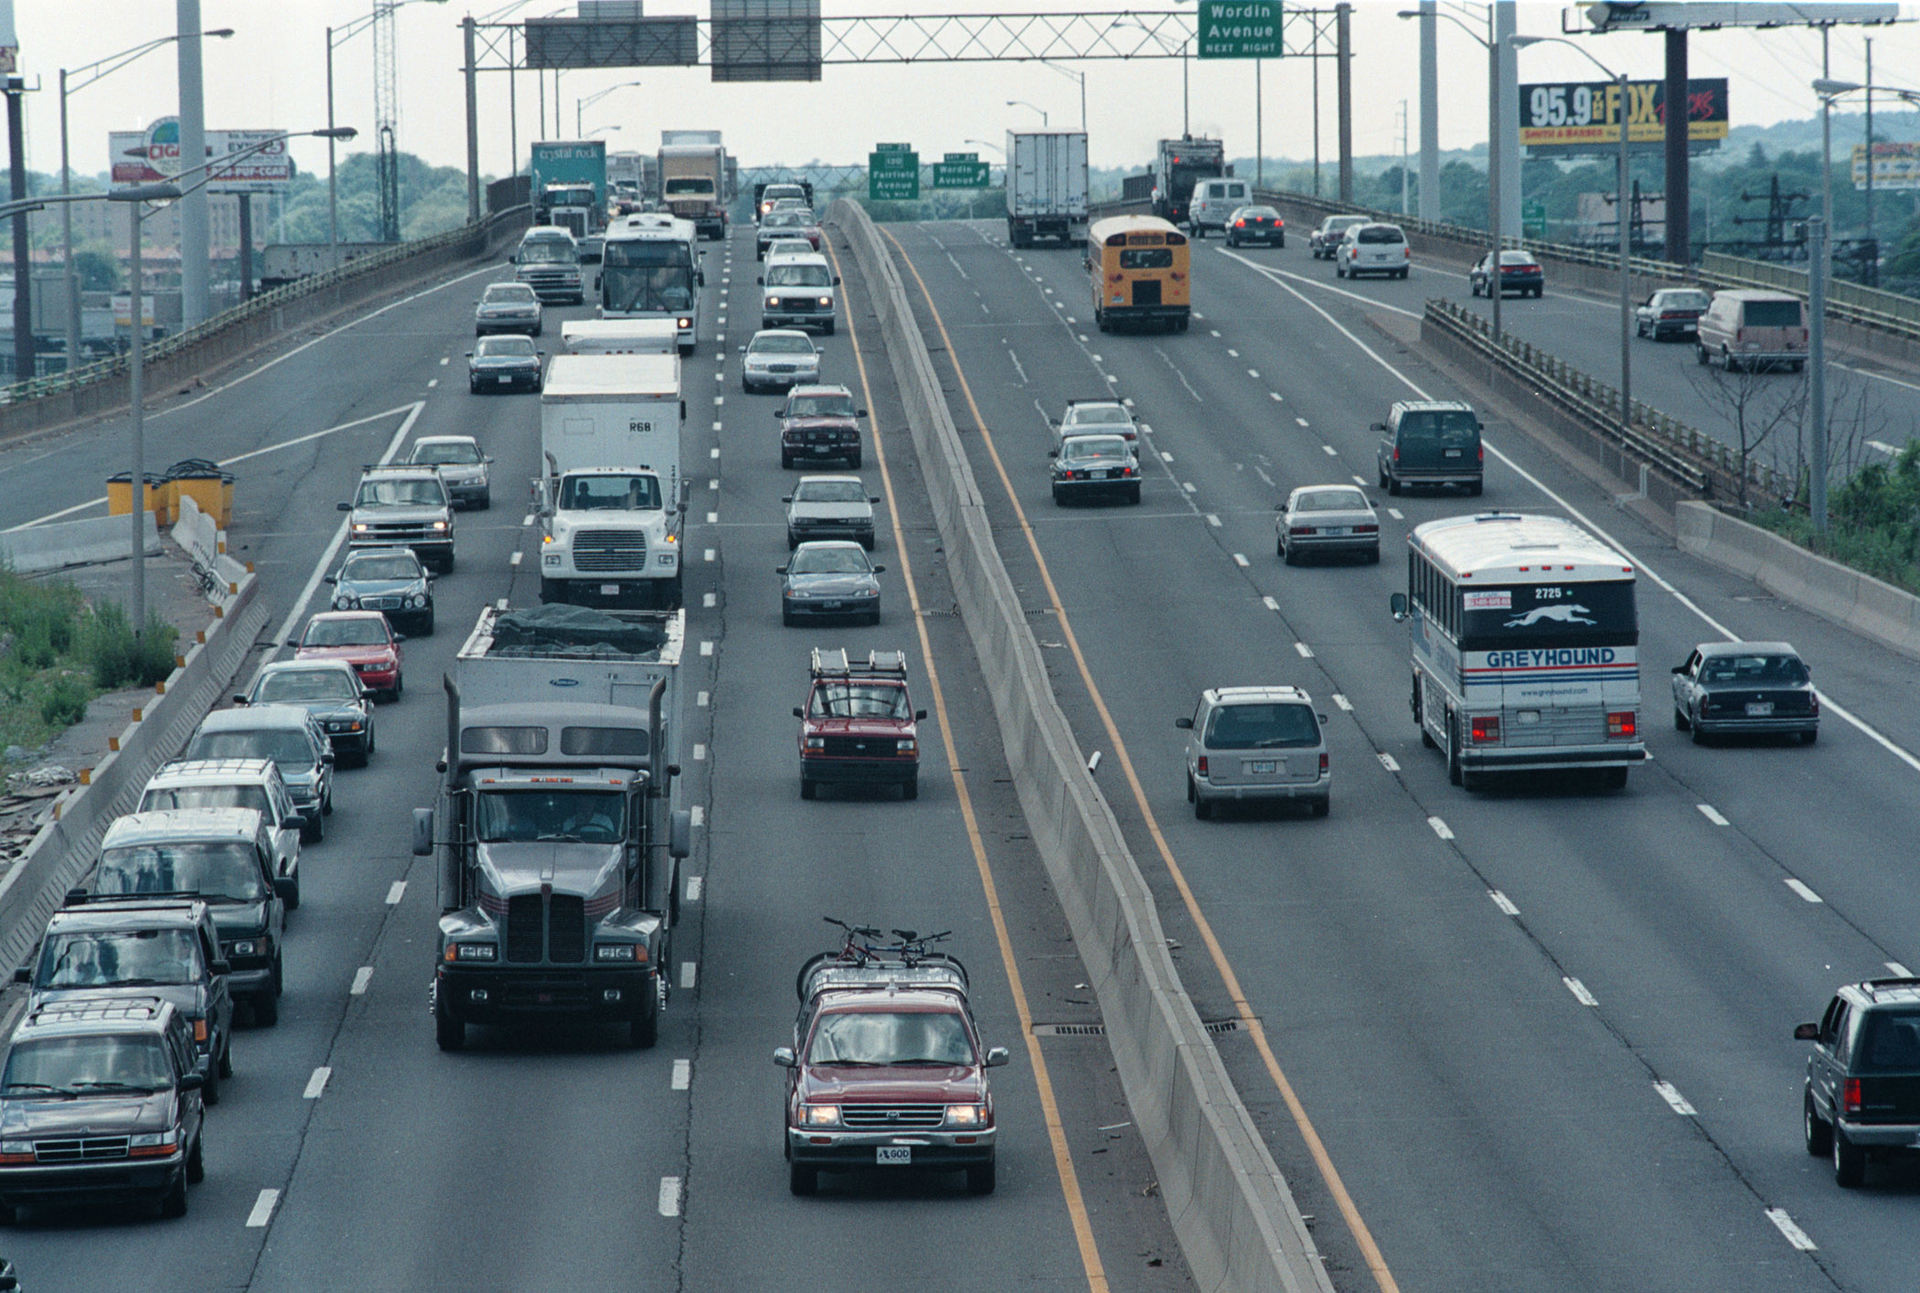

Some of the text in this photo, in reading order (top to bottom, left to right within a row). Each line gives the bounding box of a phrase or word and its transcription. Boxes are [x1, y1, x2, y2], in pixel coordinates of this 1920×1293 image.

[1211, 4, 1270, 18] Wordin
[1208, 24, 1273, 38] Avenue
[1206, 42, 1275, 53] NEXT RIGHT
[1530, 86, 1592, 127] 95.9
[540, 147, 598, 161] crystal rock
[873, 170, 915, 179] Fairfield
[877, 181, 912, 189] Avenue
[630, 422, 651, 432] R68
[1535, 587, 1562, 599] 2725
[1487, 648, 1615, 668] GREYHOUND
[1521, 687, 1588, 698] www.greyhound.com
[890, 1149, 909, 1158] GOD
